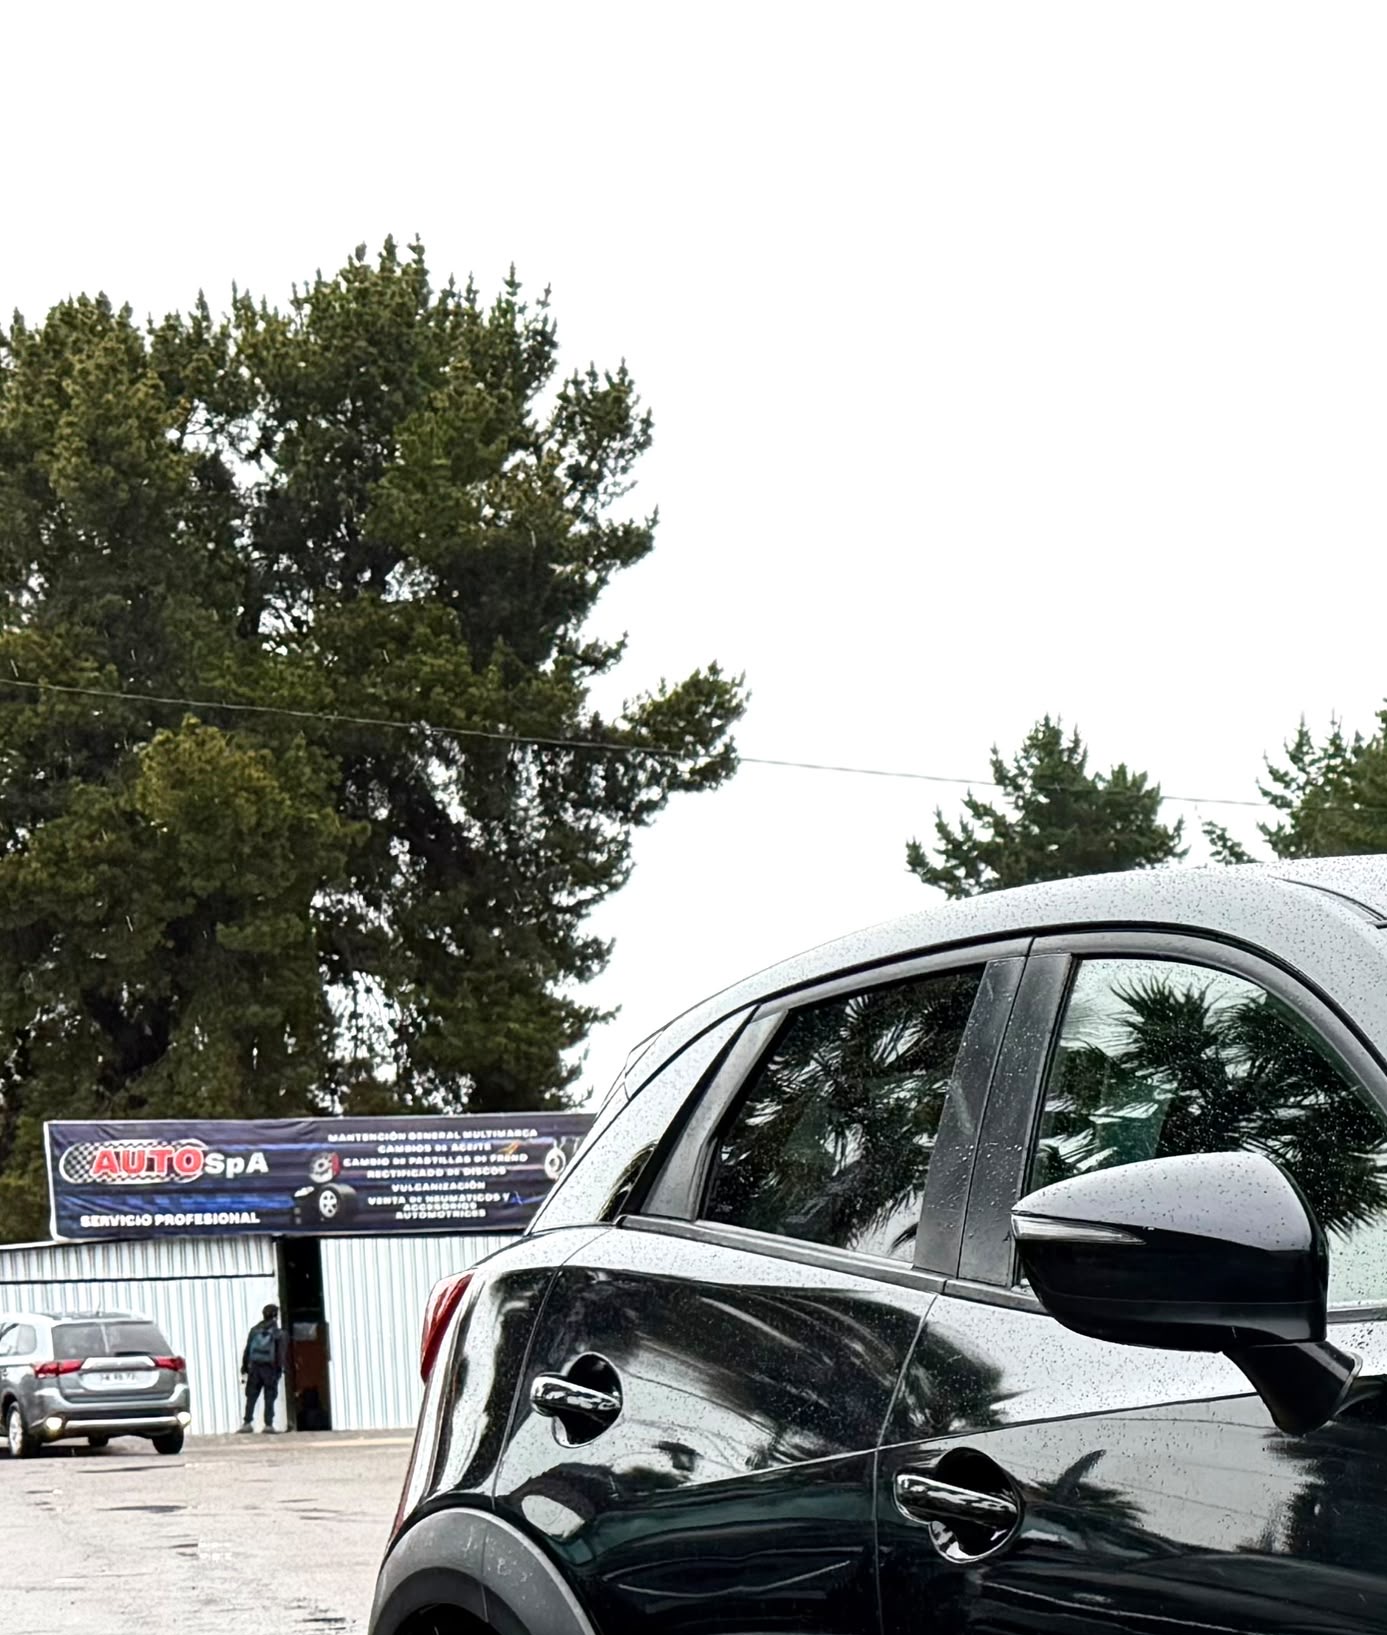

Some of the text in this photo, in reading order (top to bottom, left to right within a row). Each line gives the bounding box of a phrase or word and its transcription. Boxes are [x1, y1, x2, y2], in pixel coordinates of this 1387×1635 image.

[328, 1129, 538, 1140] MANTENCIÓN GENERAL MULTIMARCA
[378, 1144, 431, 1153] CAMBIOS
[451, 1143, 491, 1151] ACEITE
[90, 1146, 269, 1179] AUTO SpA
[343, 1157, 390, 1166] CAMBIO
[409, 1155, 471, 1164] PASTILLAS
[490, 1153, 528, 1162] FRENO
[367, 1169, 443, 1178] RECTIFICADO
[464, 1166, 506, 1175] DISCOS
[368, 1197, 406, 1205] VENTA
[80, 1211, 261, 1228] SERVICIO PROFESIONAL
